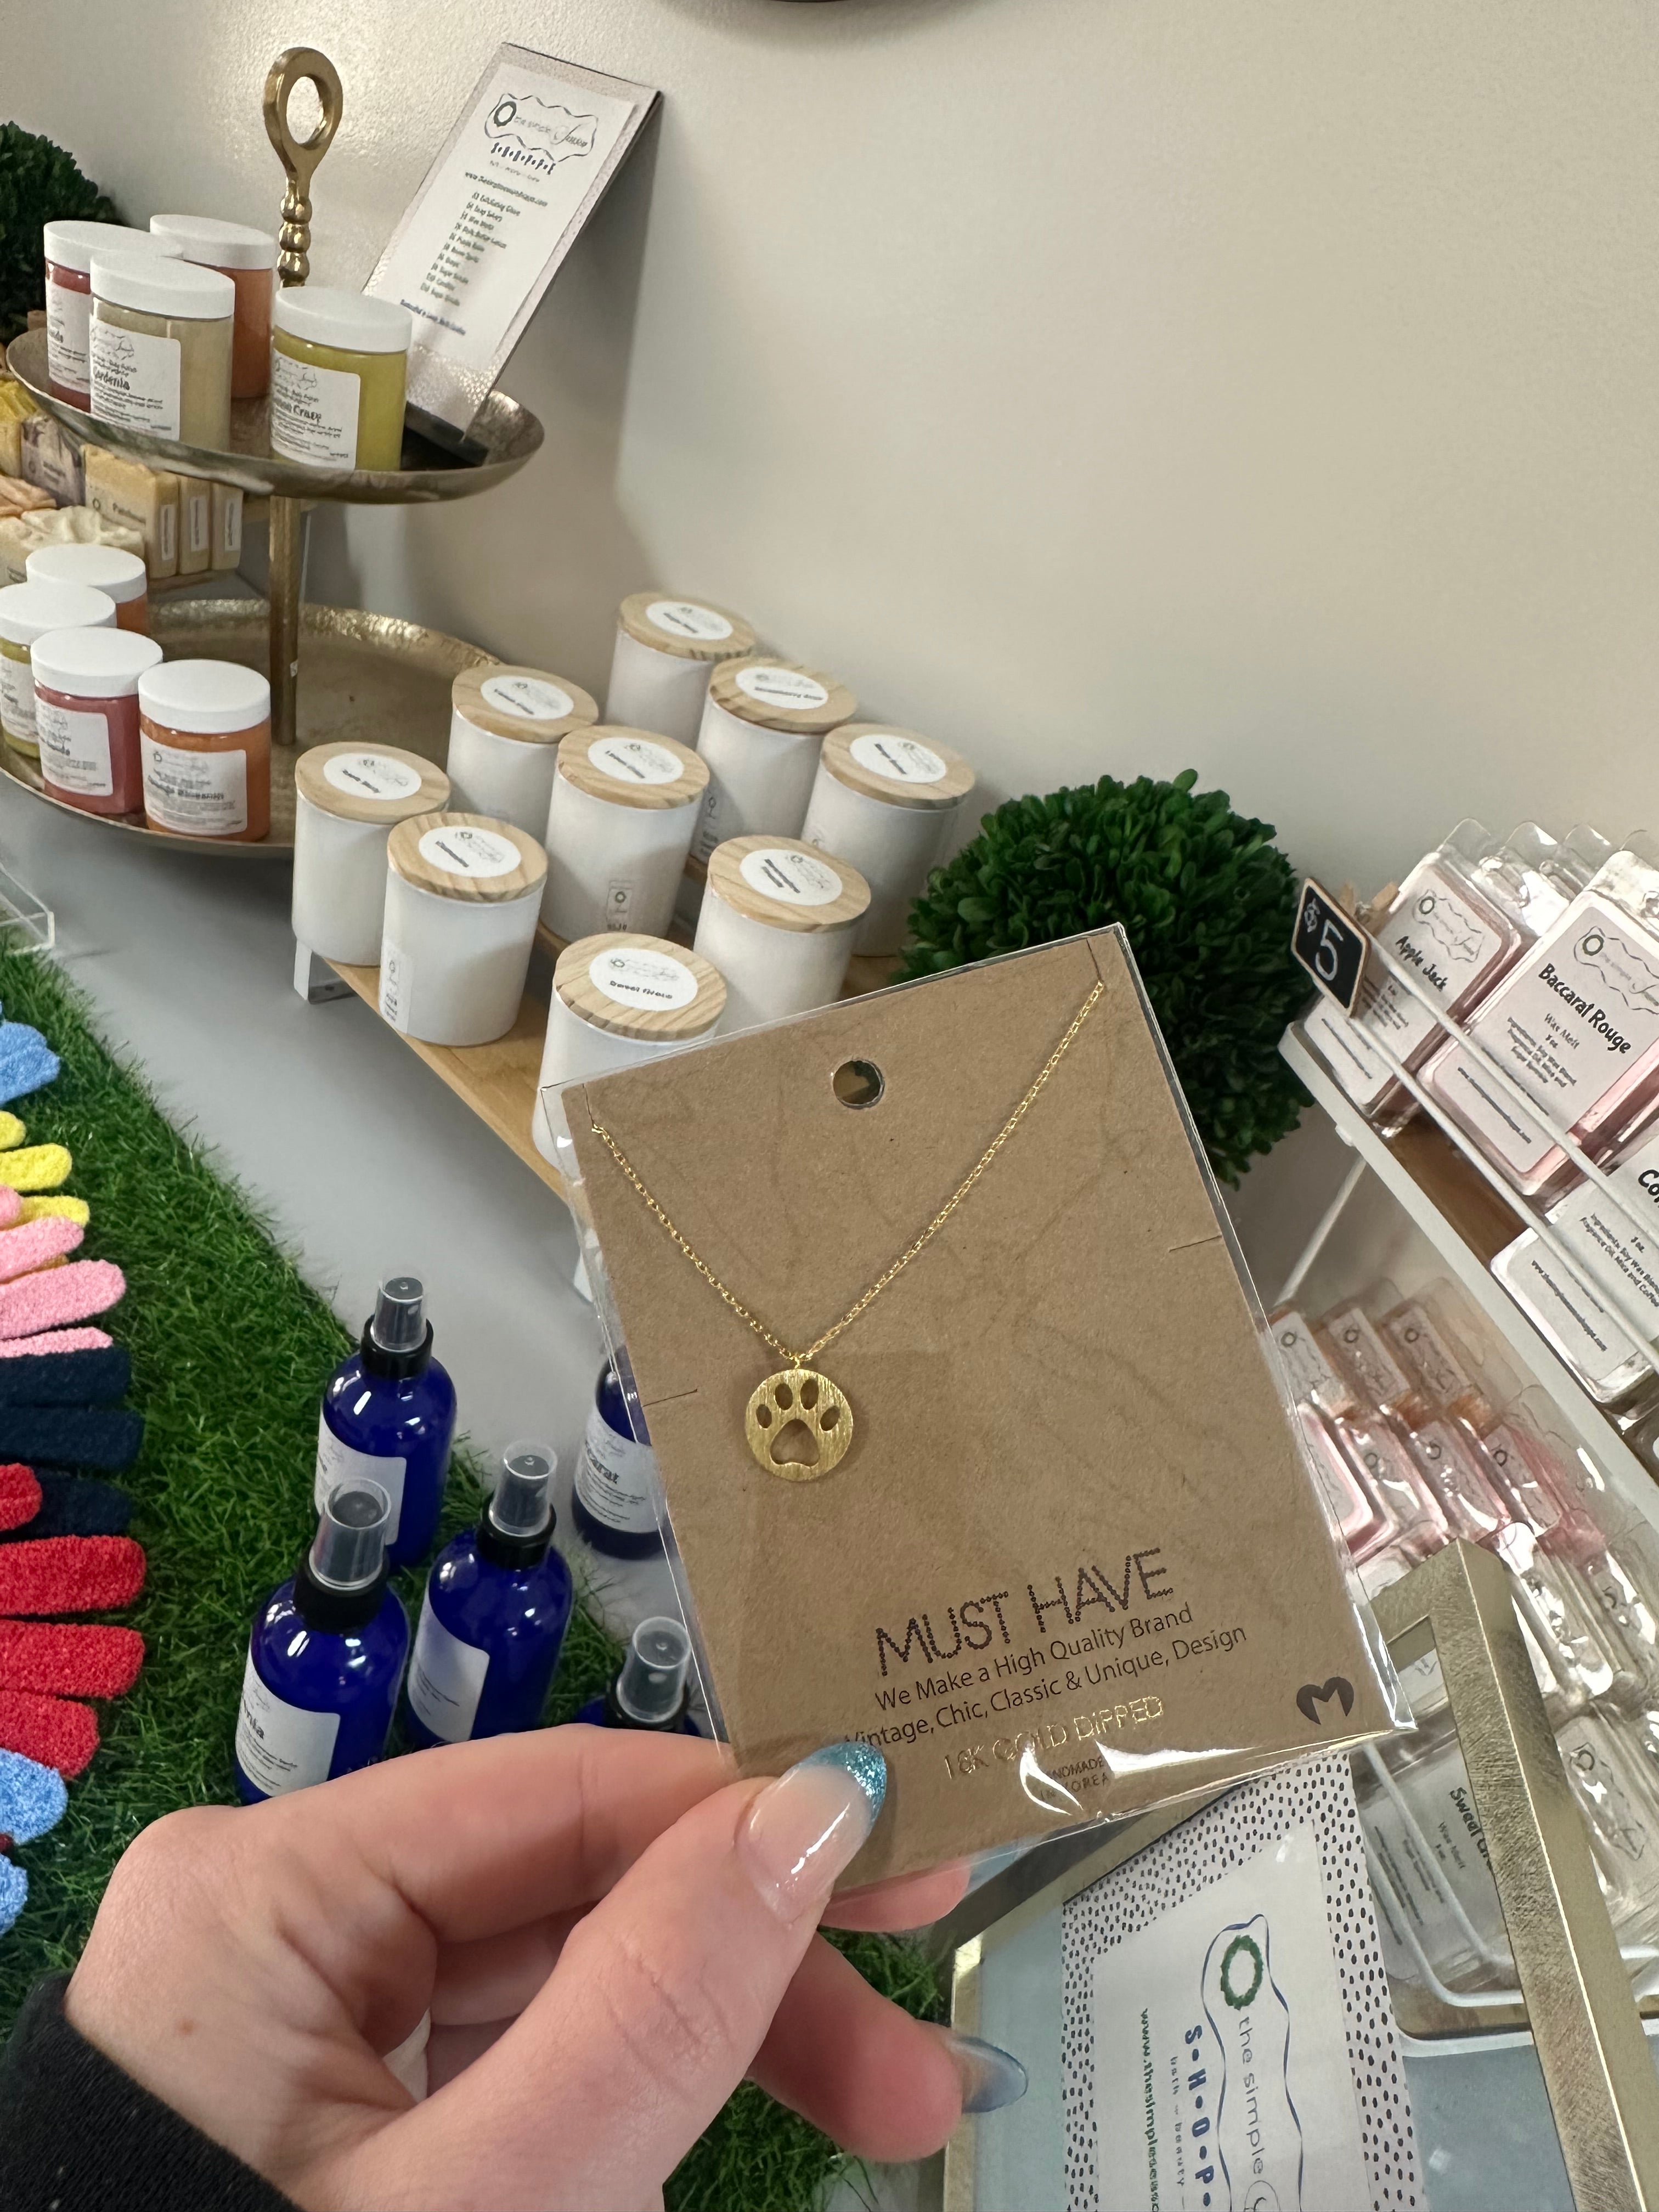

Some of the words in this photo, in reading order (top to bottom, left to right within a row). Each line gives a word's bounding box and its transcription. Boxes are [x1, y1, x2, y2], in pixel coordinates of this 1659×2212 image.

[1395, 935, 1424, 967] Apple
[1422, 963, 1448, 993] Jack
[1538, 963, 1595, 1018] Baccarat
[1588, 1009, 1631, 1054] Rouge
[1638, 1169, 1659, 1207] Co
[874, 1687, 911, 1711] We
[916, 1671, 974, 1700] Make
[978, 1667, 990, 1683] a
[994, 1647, 1046, 1678] High
[1050, 1626, 1125, 1660] Quality
[1130, 1601, 1194, 1638] Brand
[876, 1591, 1009, 1676] MUST
[1026, 1547, 1173, 1633] HAVE
[936, 1701, 988, 1728] Chic,
[990, 1679, 1062, 1712] Classic
[1066, 1671, 1082, 1690] &
[1085, 1650, 1170, 1684] Unique,
[1172, 1626, 1247, 1660] Design
[1449, 1787, 1482, 1837] Sweet
[1239, 2016, 1253, 2065] the
[1244, 2073, 1265, 2175] simple
